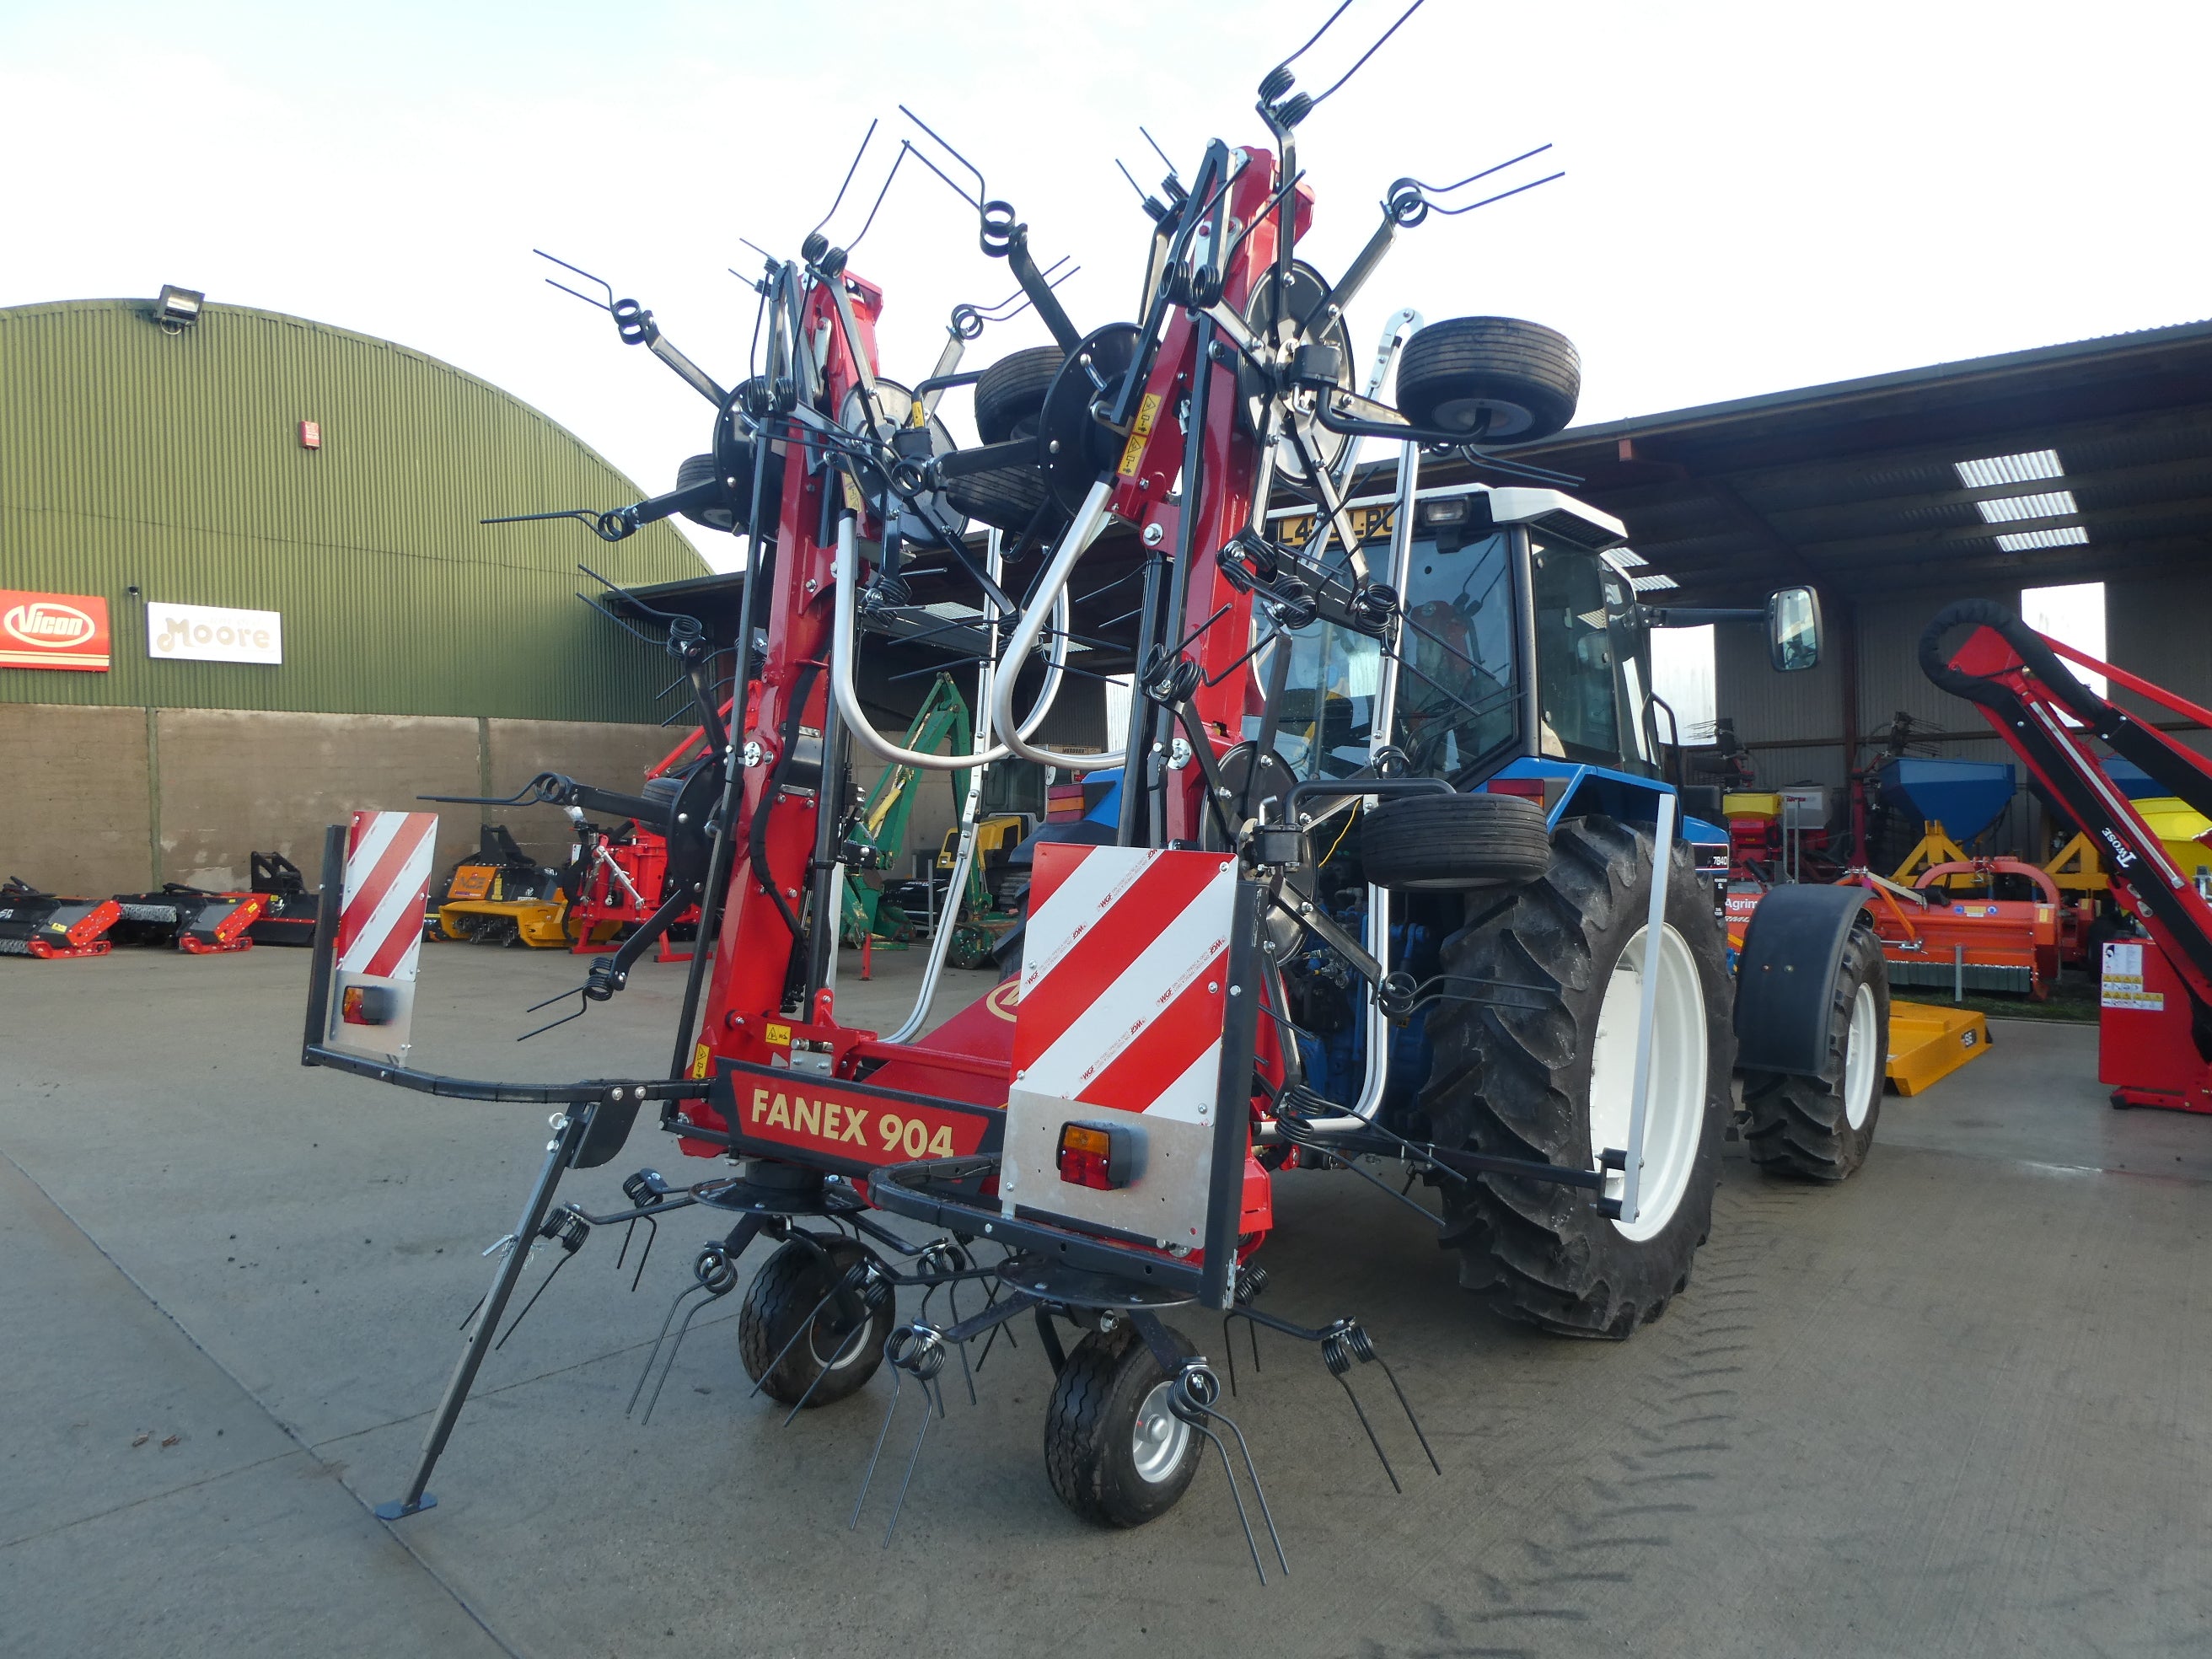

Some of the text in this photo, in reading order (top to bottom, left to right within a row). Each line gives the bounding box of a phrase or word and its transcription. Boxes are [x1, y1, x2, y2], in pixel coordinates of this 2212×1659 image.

[19, 604, 83, 636] Vicon
[156, 617, 271, 652] Moore
[1713, 856, 1727, 866] 7840
[751, 1088, 954, 1158] FANEX 904
